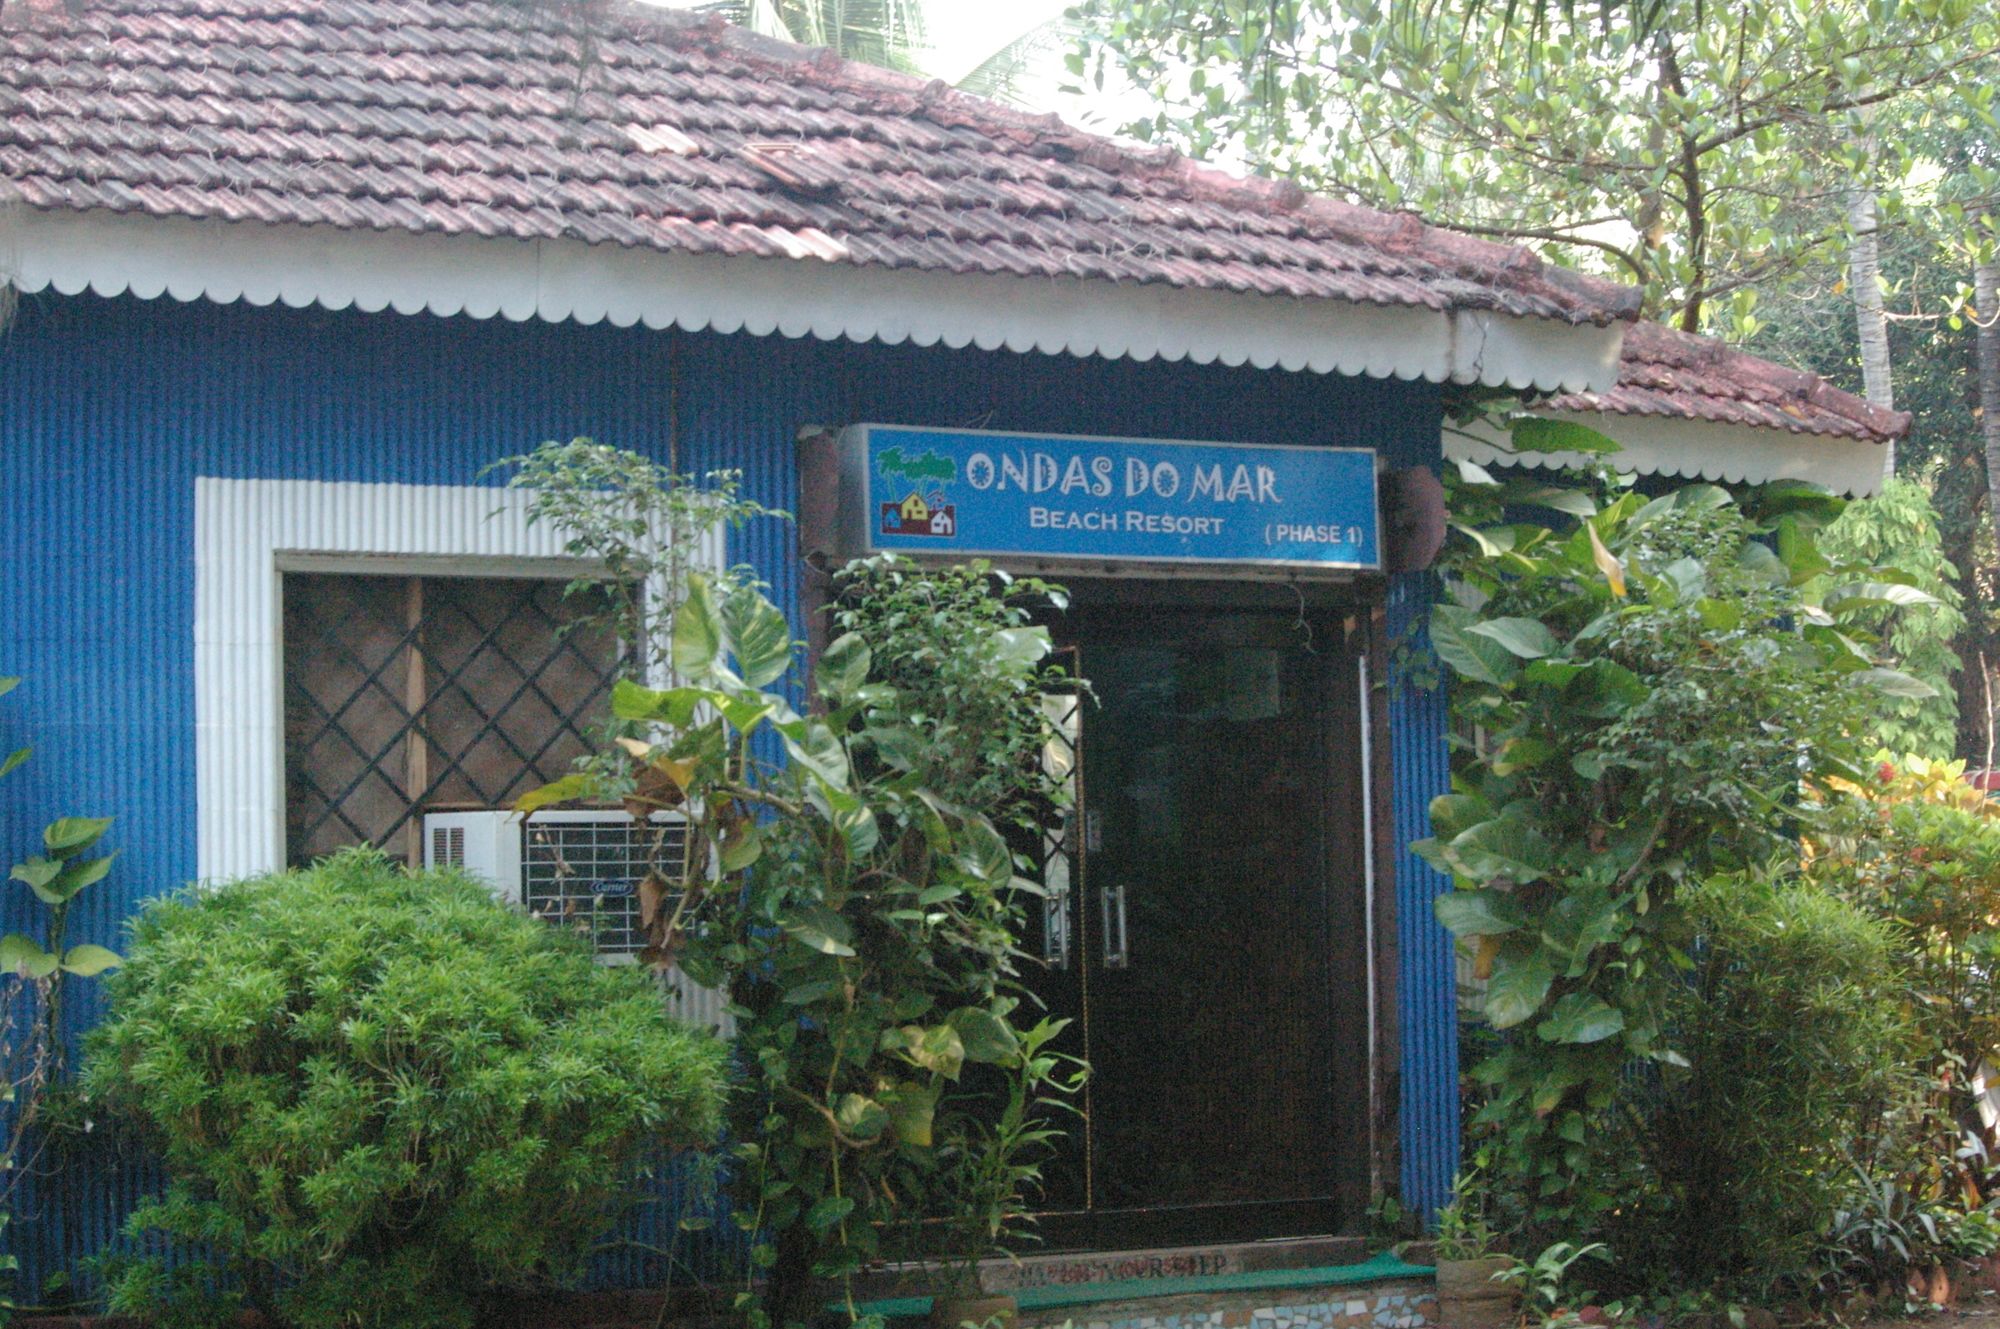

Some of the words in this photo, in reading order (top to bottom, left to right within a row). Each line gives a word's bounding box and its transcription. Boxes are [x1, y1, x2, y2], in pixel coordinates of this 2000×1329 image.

[966, 449, 1113, 498] ONDAS
[1125, 456, 1180, 498] DO
[1187, 463, 1284, 503] MAR
[1030, 506, 1118, 532] BEACH
[1125, 511, 1225, 536] RESORT
